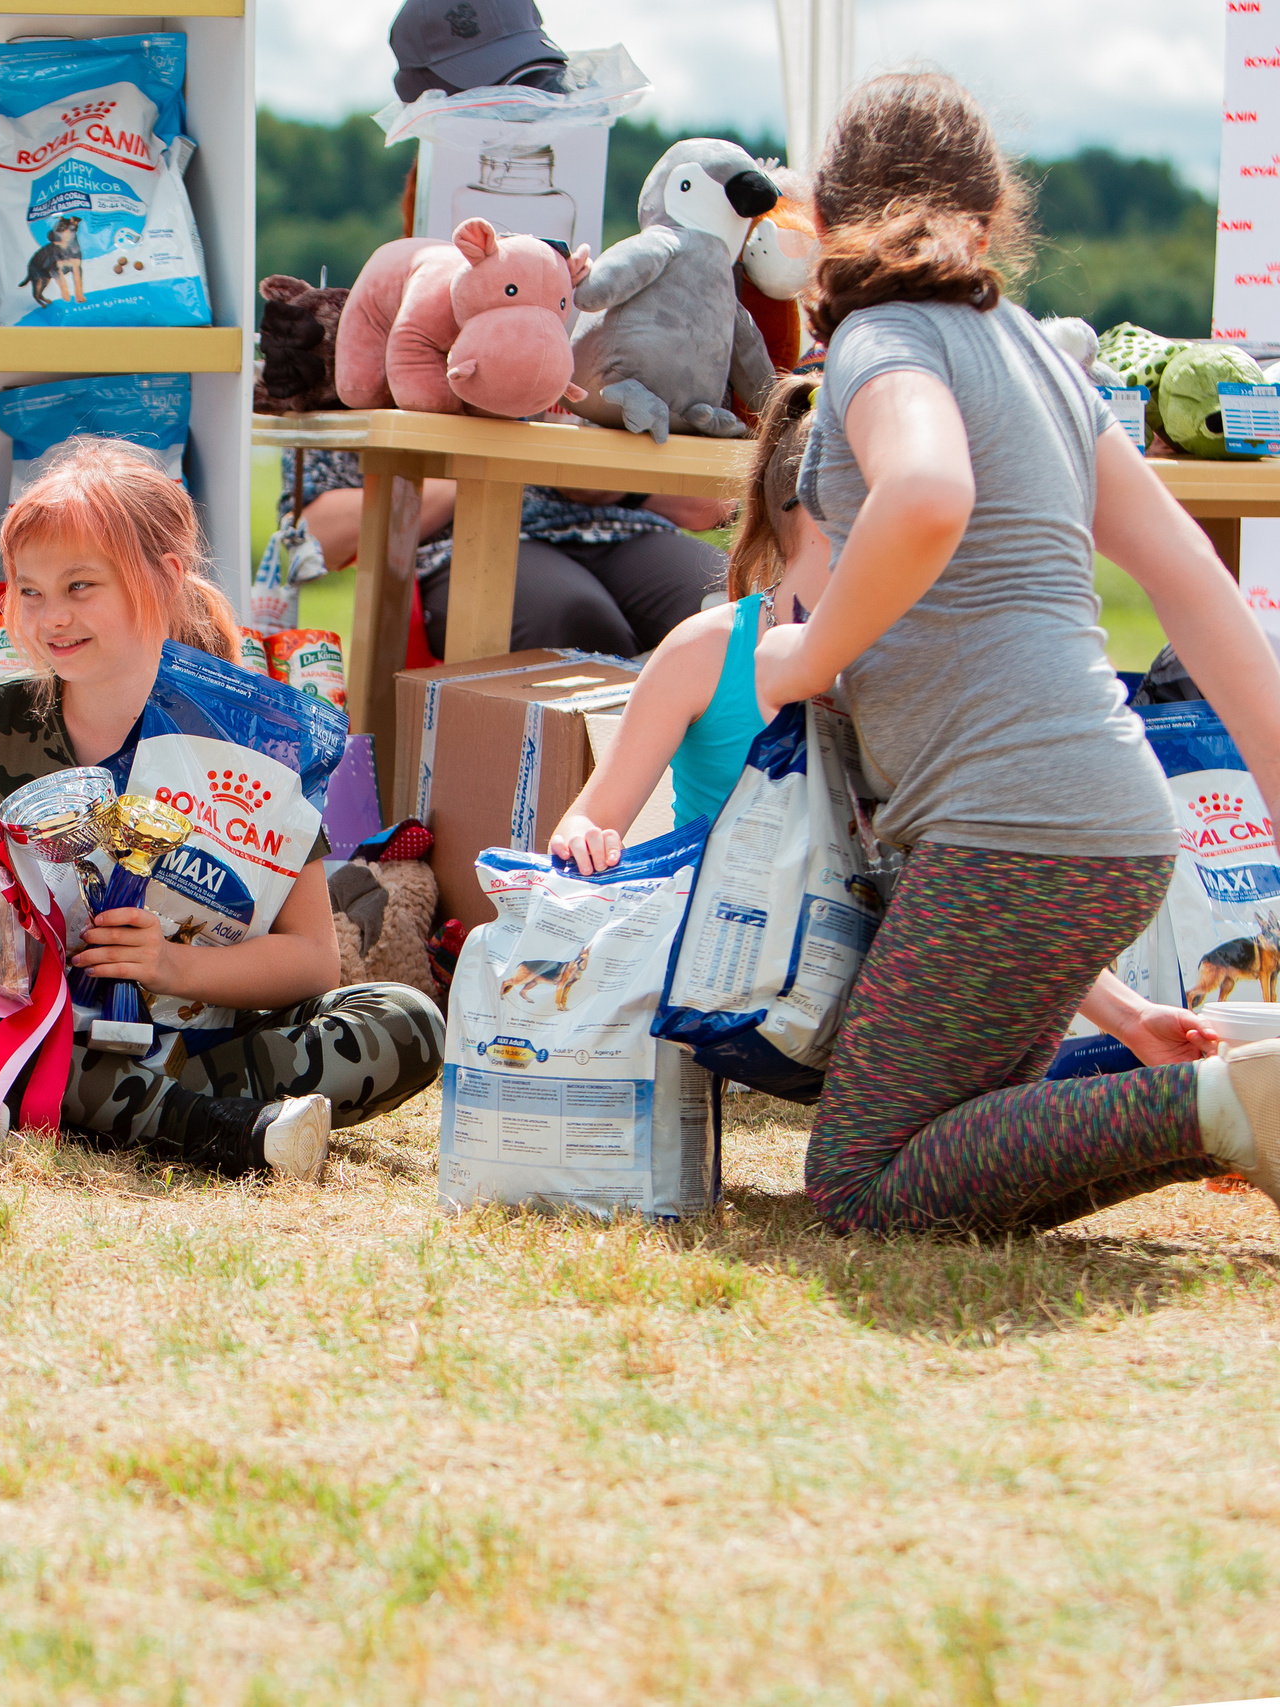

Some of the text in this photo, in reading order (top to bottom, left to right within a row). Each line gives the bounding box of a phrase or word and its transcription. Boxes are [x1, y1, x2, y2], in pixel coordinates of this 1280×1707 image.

[17, 124, 151, 164] ROYAL CANIN
[58, 162, 93, 177] PUPPY
[1240, 166, 1278, 177] ROYAL
[64, 176, 120, 191] ЩЕНКОВ
[1235, 274, 1272, 285] ROYAL
[1211, 328, 1246, 339] ANIN
[303, 654, 317, 665] Dr.
[310, 721, 315, 735] 3
[155, 787, 221, 834] ROYAL
[162, 851, 226, 893] MAXI
[1200, 869, 1256, 891] MAXI
[211, 921, 243, 942] Adult
[505, 1049, 526, 1057] Nutrition
[1089, 1046, 1107, 1054] HEALTH
[504, 1060, 525, 1068] Nutrition
